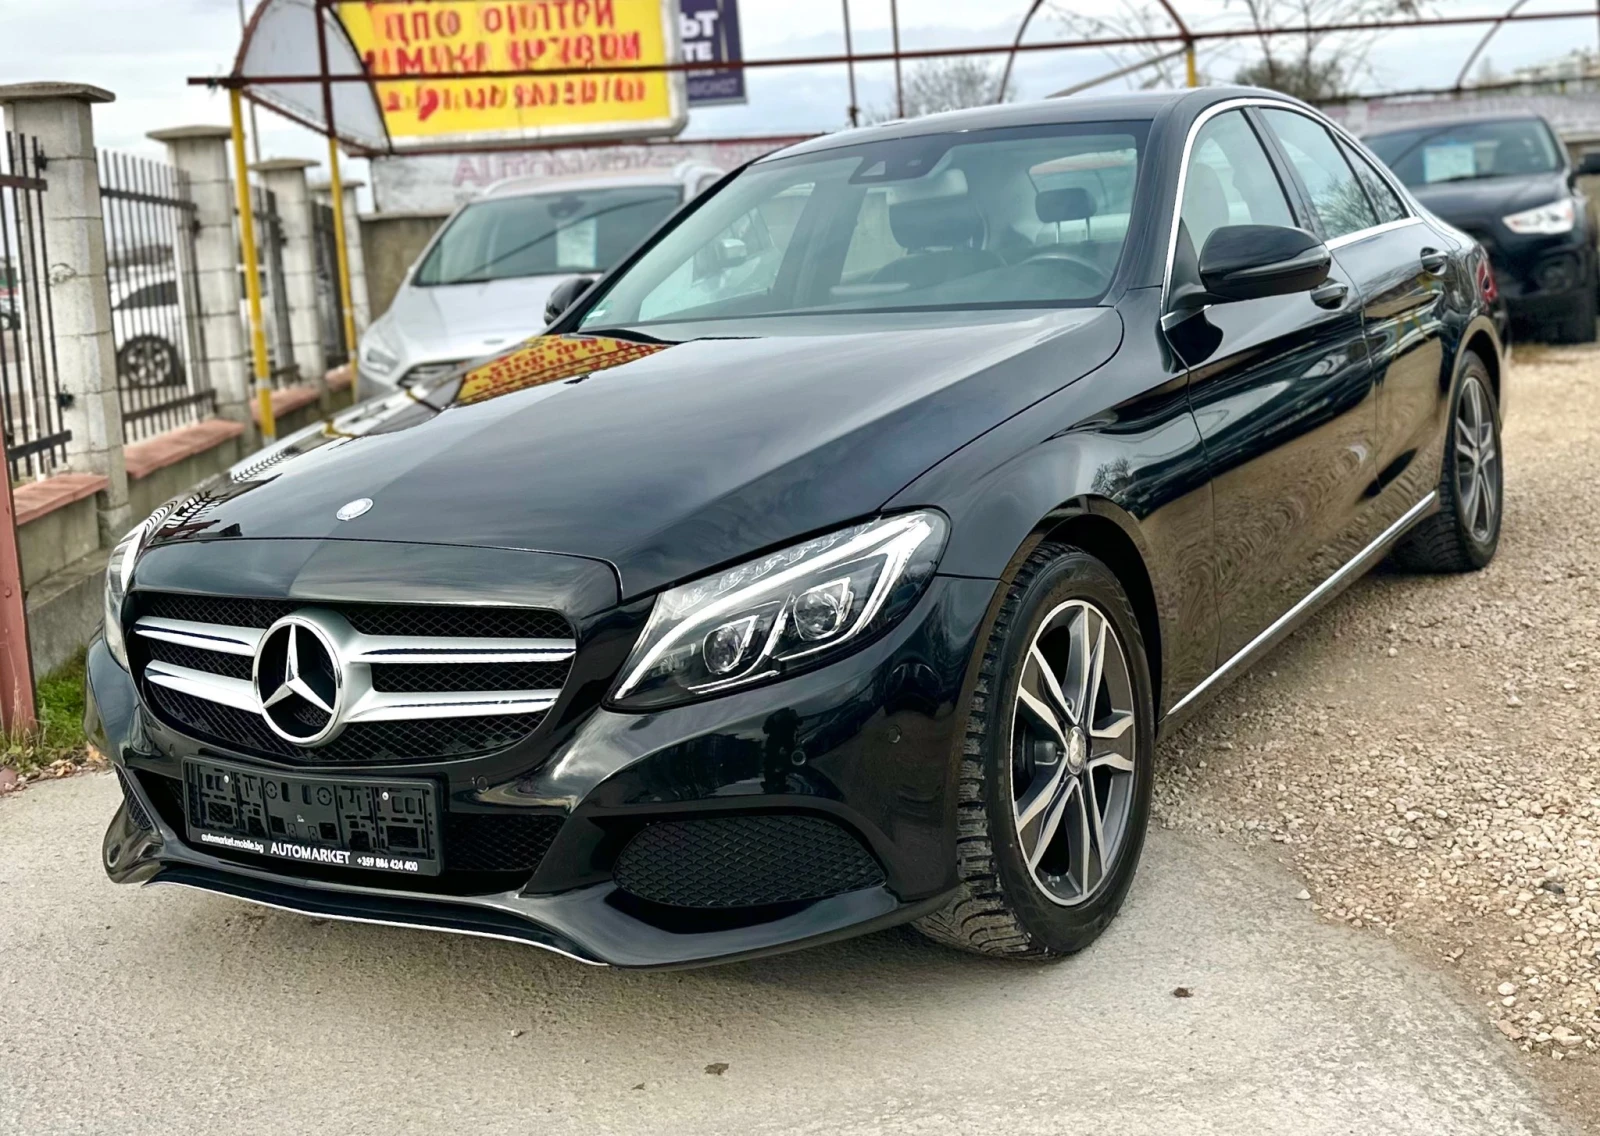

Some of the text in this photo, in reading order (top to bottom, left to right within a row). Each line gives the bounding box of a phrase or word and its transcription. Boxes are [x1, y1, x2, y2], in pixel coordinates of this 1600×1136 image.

[201, 833, 264, 854] automarket.mobile.bg
[270, 842, 351, 865] AUTOMARKET
[357, 856, 375, 867] +359
[389, 859, 404, 871] 424
[404, 860, 418, 872] 400
